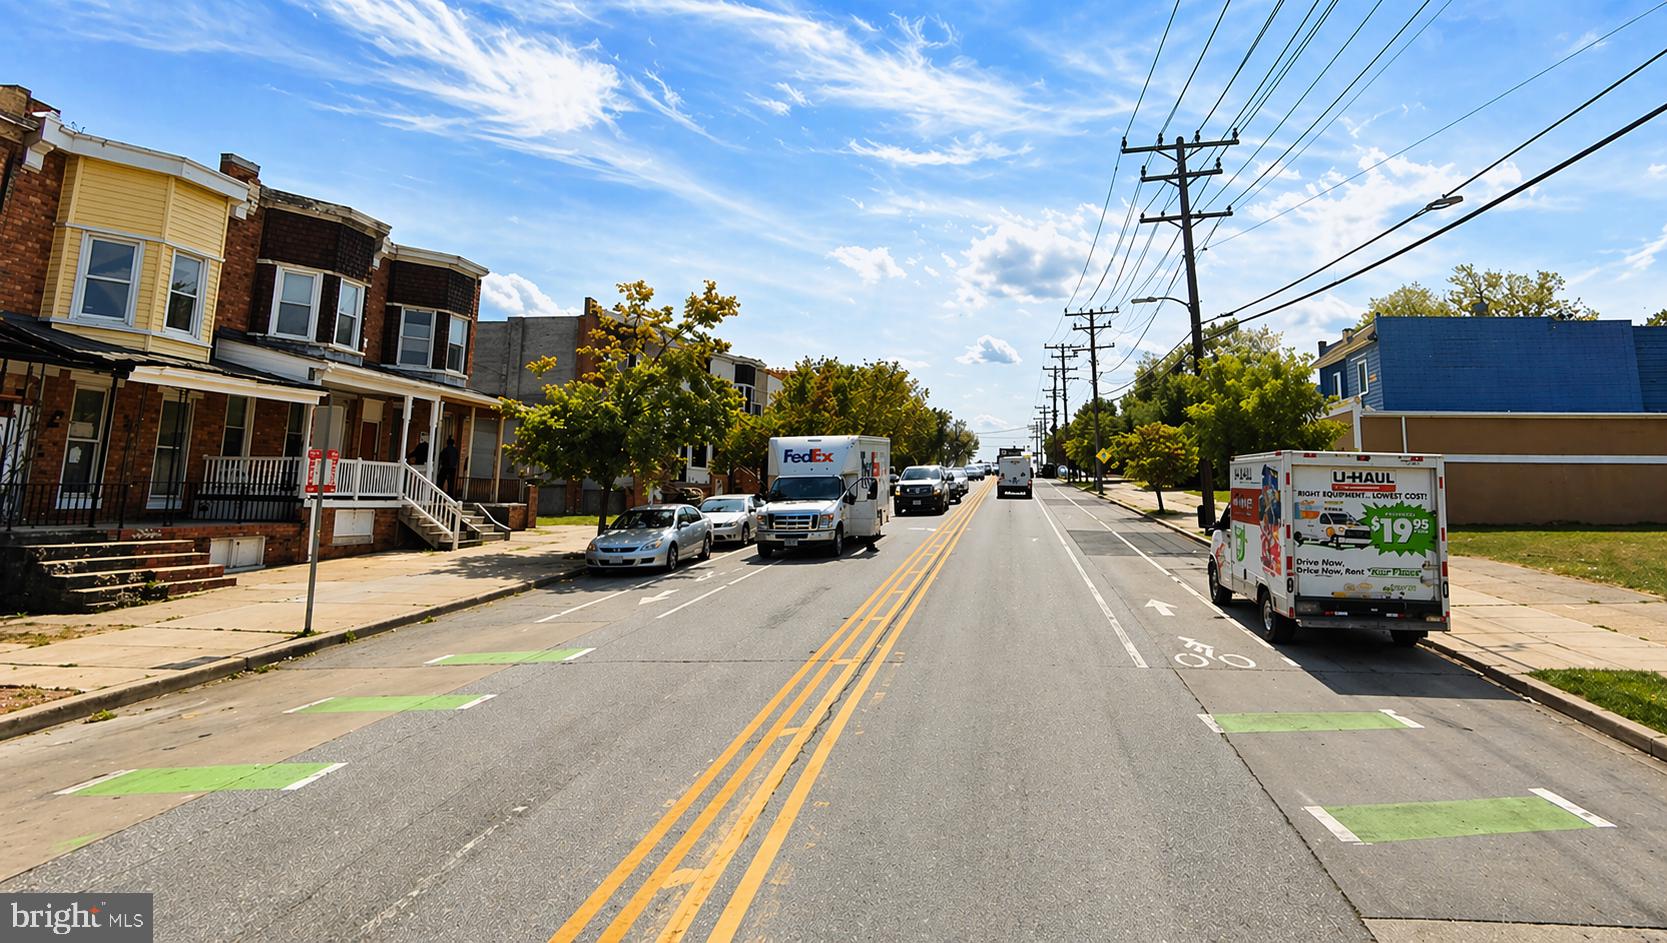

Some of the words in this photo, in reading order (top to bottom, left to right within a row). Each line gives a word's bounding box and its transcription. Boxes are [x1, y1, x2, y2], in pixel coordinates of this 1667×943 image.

[783, 448, 834, 463] FedEx
[1333, 471, 1395, 484] U-HAUL
[1297, 490, 1320, 498] RIGHT
[1372, 492, 1402, 500] LOWEST
[1404, 493, 1428, 501] COST!
